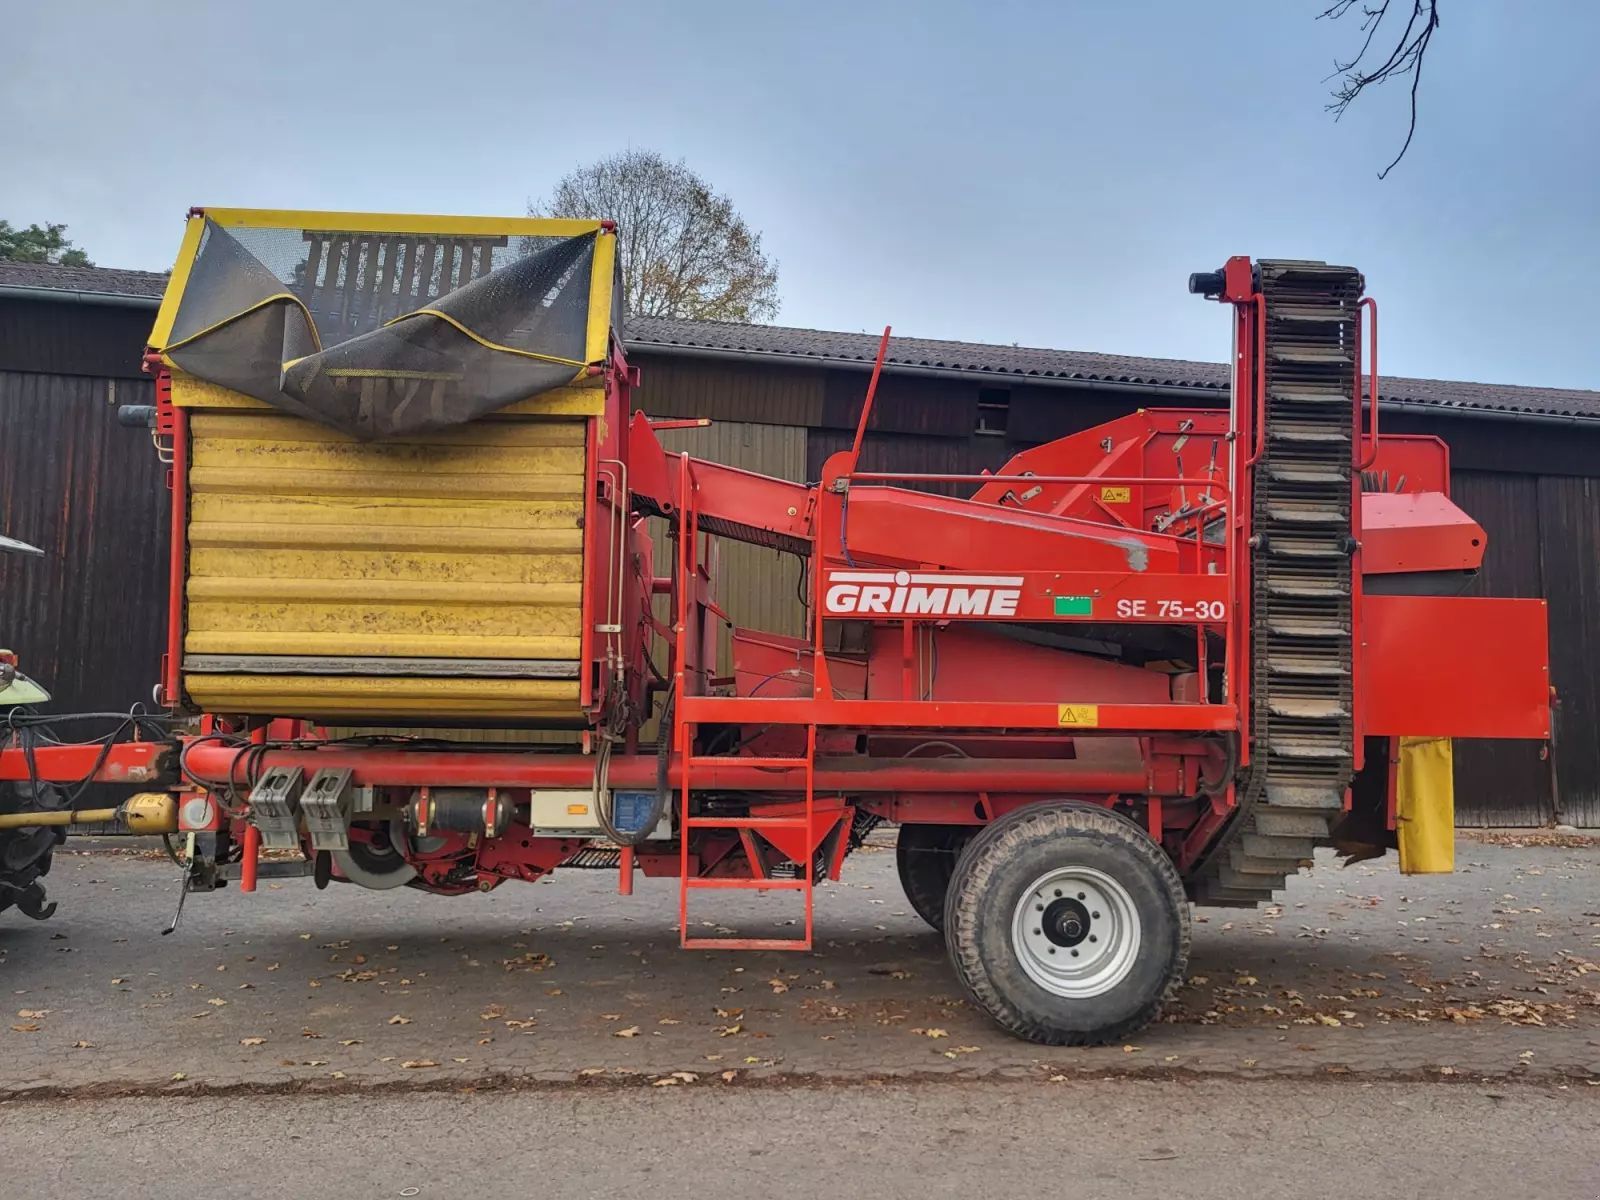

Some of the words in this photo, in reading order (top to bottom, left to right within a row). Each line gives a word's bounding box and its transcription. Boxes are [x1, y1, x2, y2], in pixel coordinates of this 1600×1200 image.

[826, 571, 1021, 616] GRIMME
[1116, 599, 1146, 618] SE
[1157, 600, 1225, 619] 75-30
